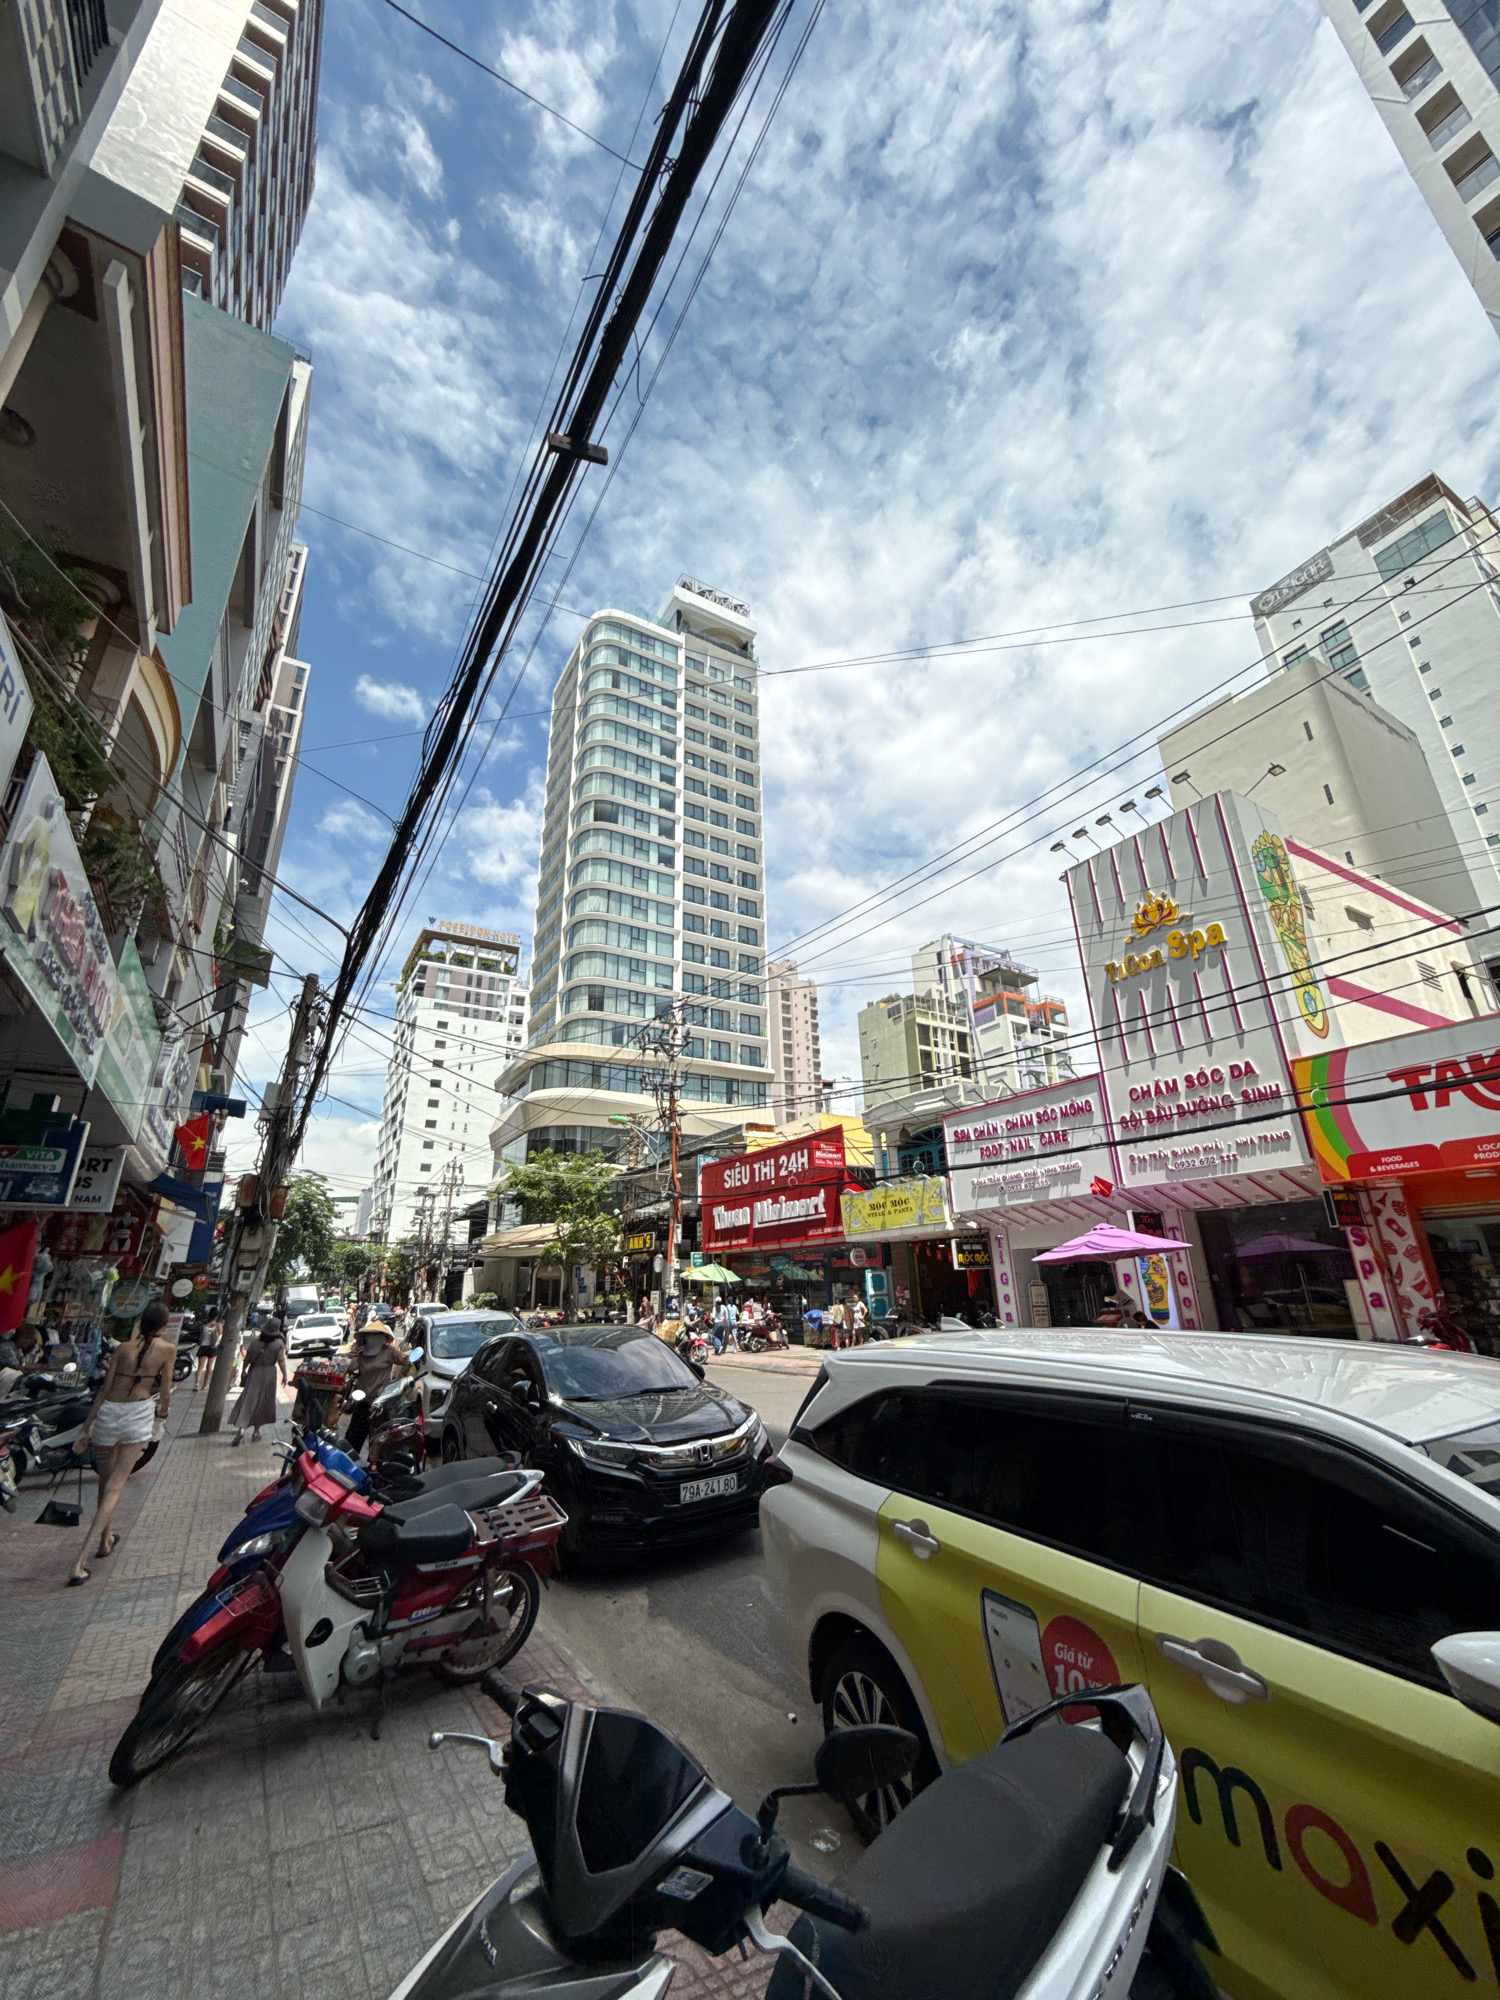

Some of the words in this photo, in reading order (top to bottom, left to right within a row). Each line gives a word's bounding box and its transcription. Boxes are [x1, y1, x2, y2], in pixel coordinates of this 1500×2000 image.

[439, 919, 491, 938] POSEIDON
[1167, 922, 1226, 960] Spa
[1129, 1078, 1179, 1102] CHĂM
[1184, 1067, 1224, 1090] SÓC
[1229, 1060, 1257, 1080] DA
[1241, 1083, 1282, 1105] SINH
[954, 1129, 971, 1143] SPA
[1005, 1112, 1034, 1131] CHĂM
[1036, 1105, 1058, 1124] SÓC
[980, 1143, 1005, 1159] FOOT
[1010, 1138, 1034, 1152] NAIL
[1040, 1129, 1069, 1146] CARE
[1235, 1136, 1256, 1146] NHA
[1257, 1130, 1291, 1143] TRANG
[26, 1151, 55, 1159] VITA
[1377, 1160, 1420, 1172] BEVERAGES
[1381, 1155, 1403, 1163] FOOD
[724, 1162, 750, 1189] SIÊU
[753, 1158, 775, 1185] THỊ
[779, 1149, 808, 1177] 24H
[1044, 1167, 1057, 1175] NHA
[1059, 1162, 1080, 1172] TRANG
[74, 1195, 102, 1203] NAM
[753, 1188, 826, 1228] Minimart
[894, 1206, 913, 1214] PASTA
[1054, 1642, 1075, 1662] Giá
[1077, 1650, 1094, 1670] từ
[1054, 1664, 1086, 1696] 10
